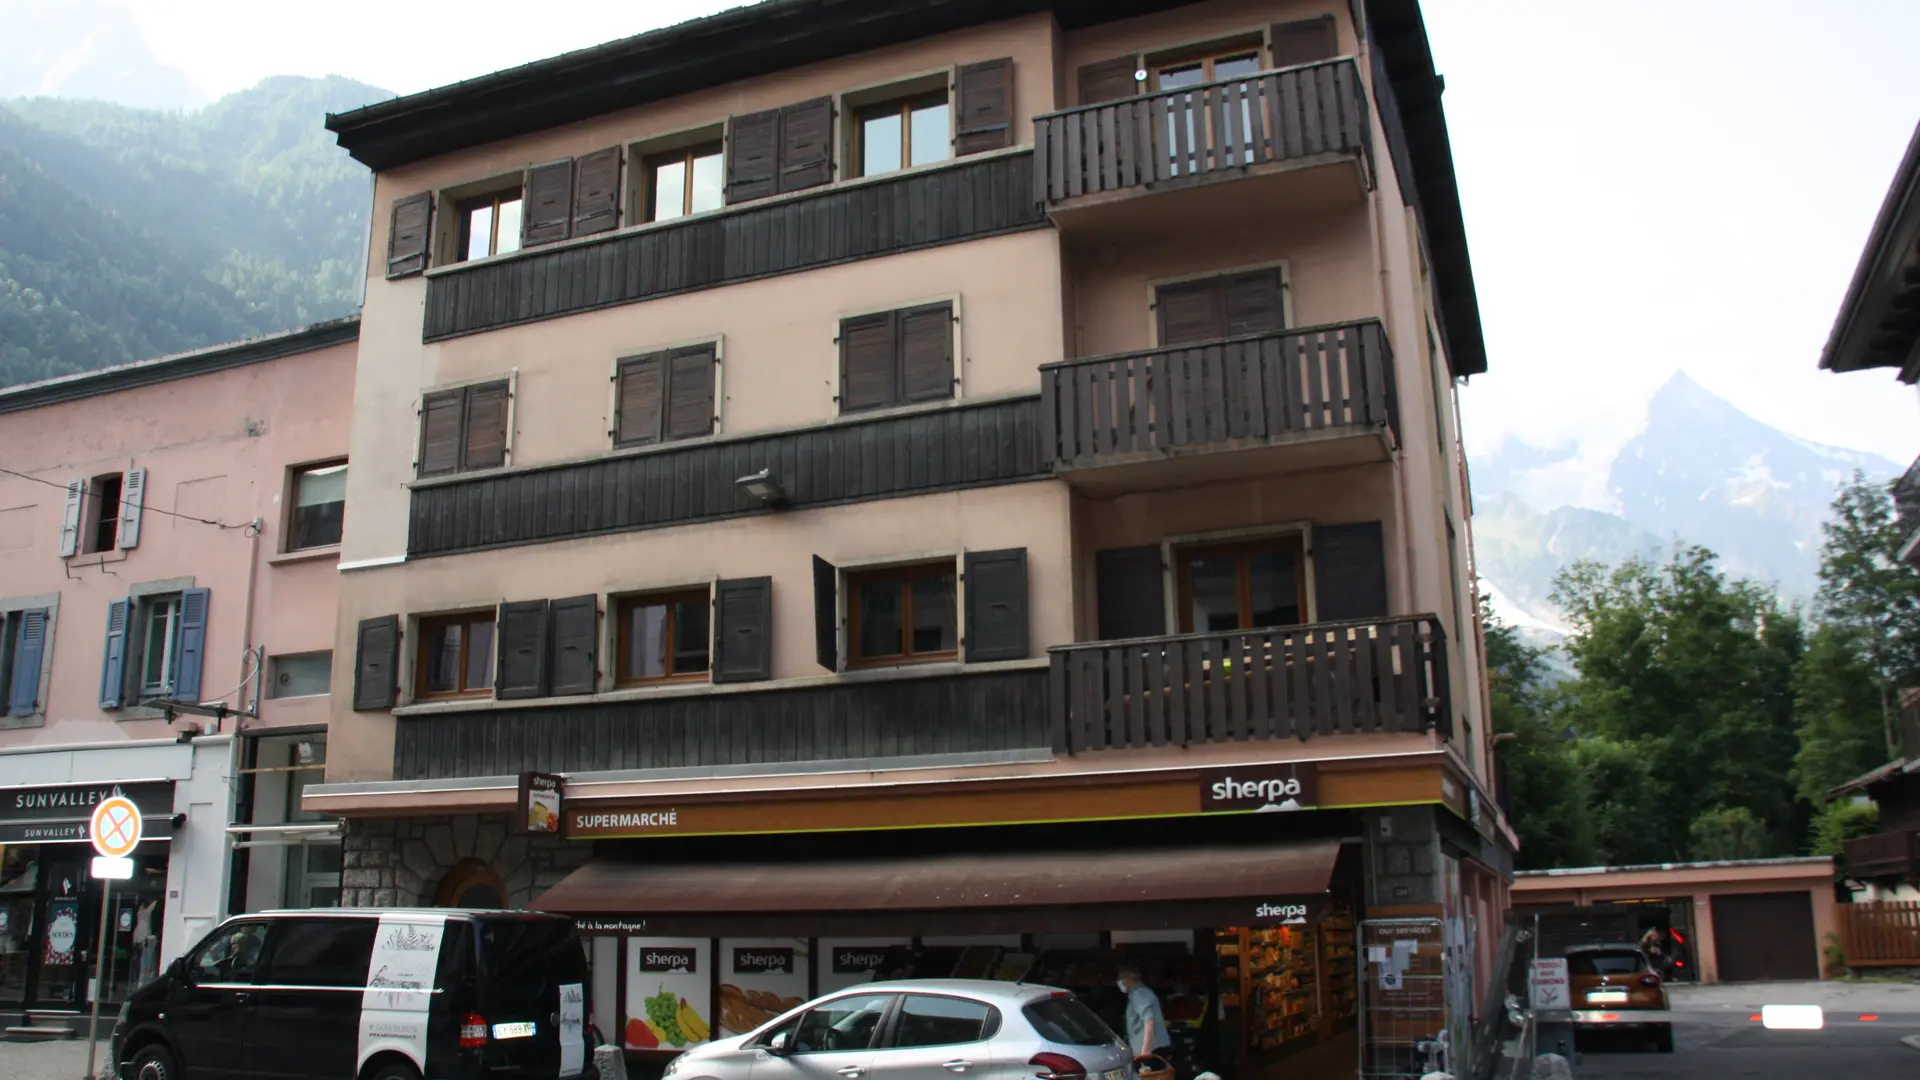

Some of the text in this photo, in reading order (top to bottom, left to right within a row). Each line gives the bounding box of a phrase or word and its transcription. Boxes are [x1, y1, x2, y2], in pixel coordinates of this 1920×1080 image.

[533, 776, 556, 788] sherpa
[1212, 777, 1301, 801] sherpa
[16, 790, 108, 808] SUNVALLEY
[576, 808, 677, 828] SUPERMARCHÉ
[24, 828, 76, 838] SUNVALLEY
[1256, 903, 1307, 917] sherpa
[587, 921, 593, 930] à
[595, 920, 602, 930] la
[603, 920, 641, 932] montagne
[646, 952, 689, 967] sherpa
[740, 953, 786, 967] sherpa
